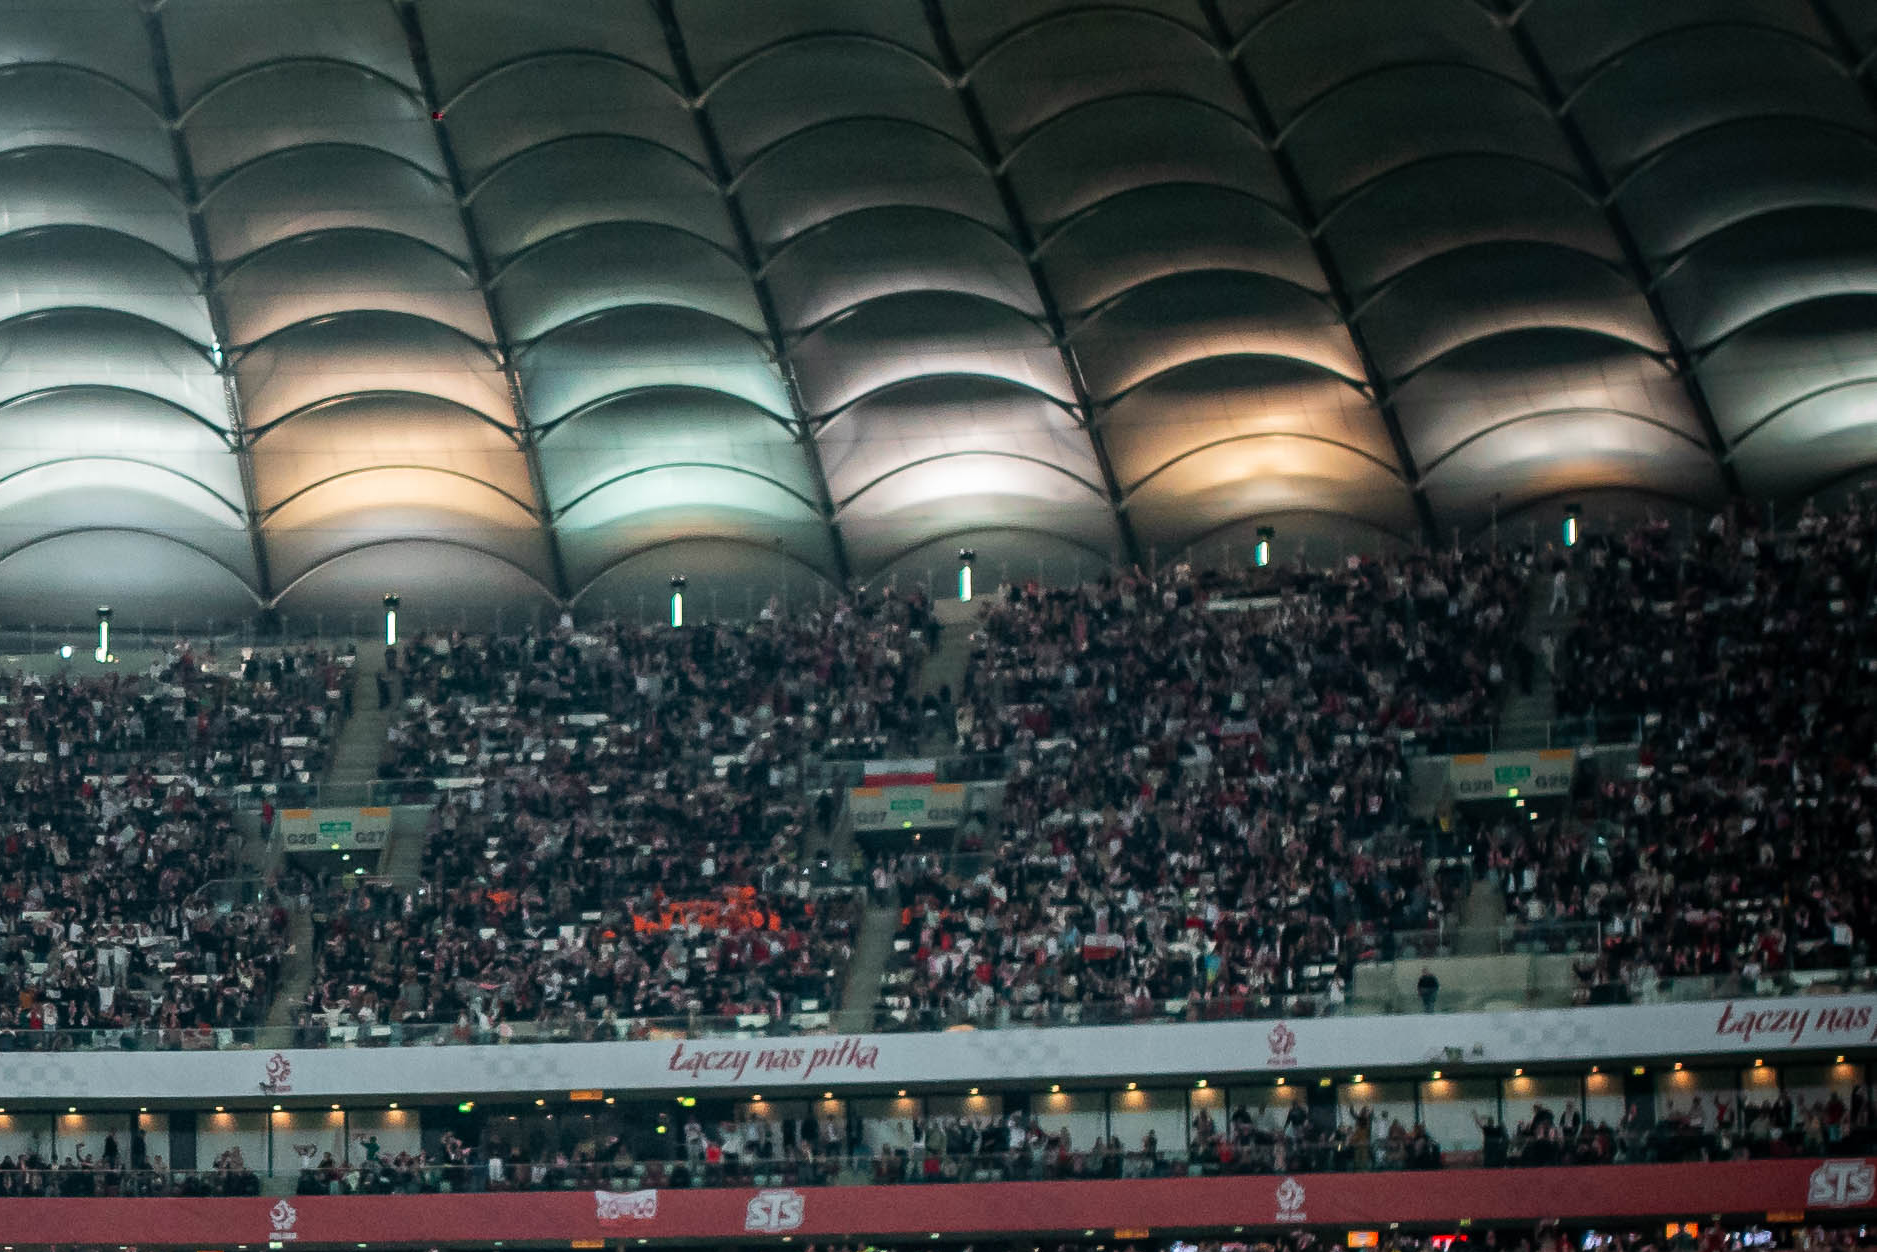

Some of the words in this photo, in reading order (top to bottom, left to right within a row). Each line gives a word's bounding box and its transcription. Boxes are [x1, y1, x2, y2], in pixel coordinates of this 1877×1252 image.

[1715, 1000, 1812, 1044] Łączy
[1815, 1006, 1873, 1033] nas
[668, 1042, 751, 1081] Łączy
[754, 1049, 804, 1073] nas
[802, 1037, 879, 1080] piłka
[1808, 1160, 1875, 1207] STS
[746, 1190, 805, 1232] STS
